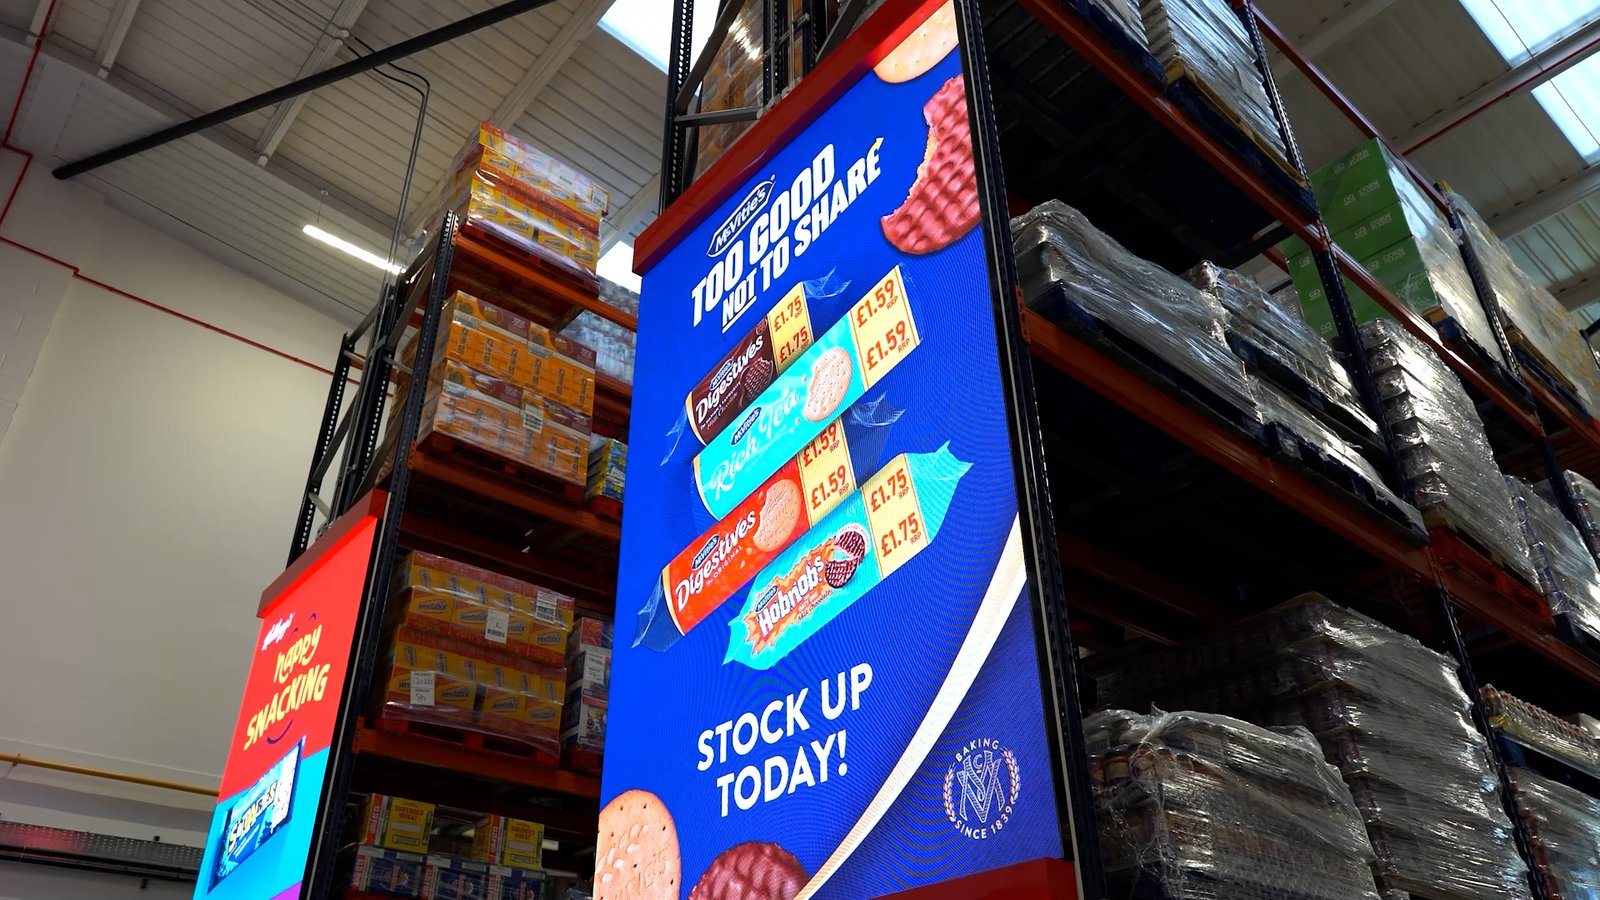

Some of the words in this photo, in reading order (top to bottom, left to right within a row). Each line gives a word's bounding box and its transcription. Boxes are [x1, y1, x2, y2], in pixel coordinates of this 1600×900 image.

[691, 240, 744, 328] TOO
[749, 143, 835, 265] GOOD
[714, 187, 767, 251] McVitie's
[722, 267, 757, 327] NOT
[760, 237, 790, 292] TO
[794, 137, 885, 256] SHARE
[773, 295, 802, 332] £1.75
[856, 278, 895, 328] £1.59
[886, 295, 899, 310] RRP
[779, 326, 808, 364] £1.75
[866, 320, 906, 370] £1.59
[898, 338, 911, 353] RRP
[695, 335, 763, 424] Digestives
[709, 432, 760, 501] Rich
[759, 387, 800, 439] Tea
[803, 423, 837, 468] £1.59
[811, 464, 846, 510] £1.59
[870, 468, 907, 512] £1.75
[881, 512, 919, 557] £1.75
[675, 510, 756, 612] Digestives
[713, 545, 743, 578] ORIGINAL
[244, 663, 331, 751] SNACKING
[697, 687, 811, 771] STOCK
[821, 662, 873, 720] UP
[716, 729, 848, 817] TODAY!
[955, 738, 999, 762] BAKING
[955, 820, 987, 839] SINCE
[991, 806, 1012, 834] 1839
